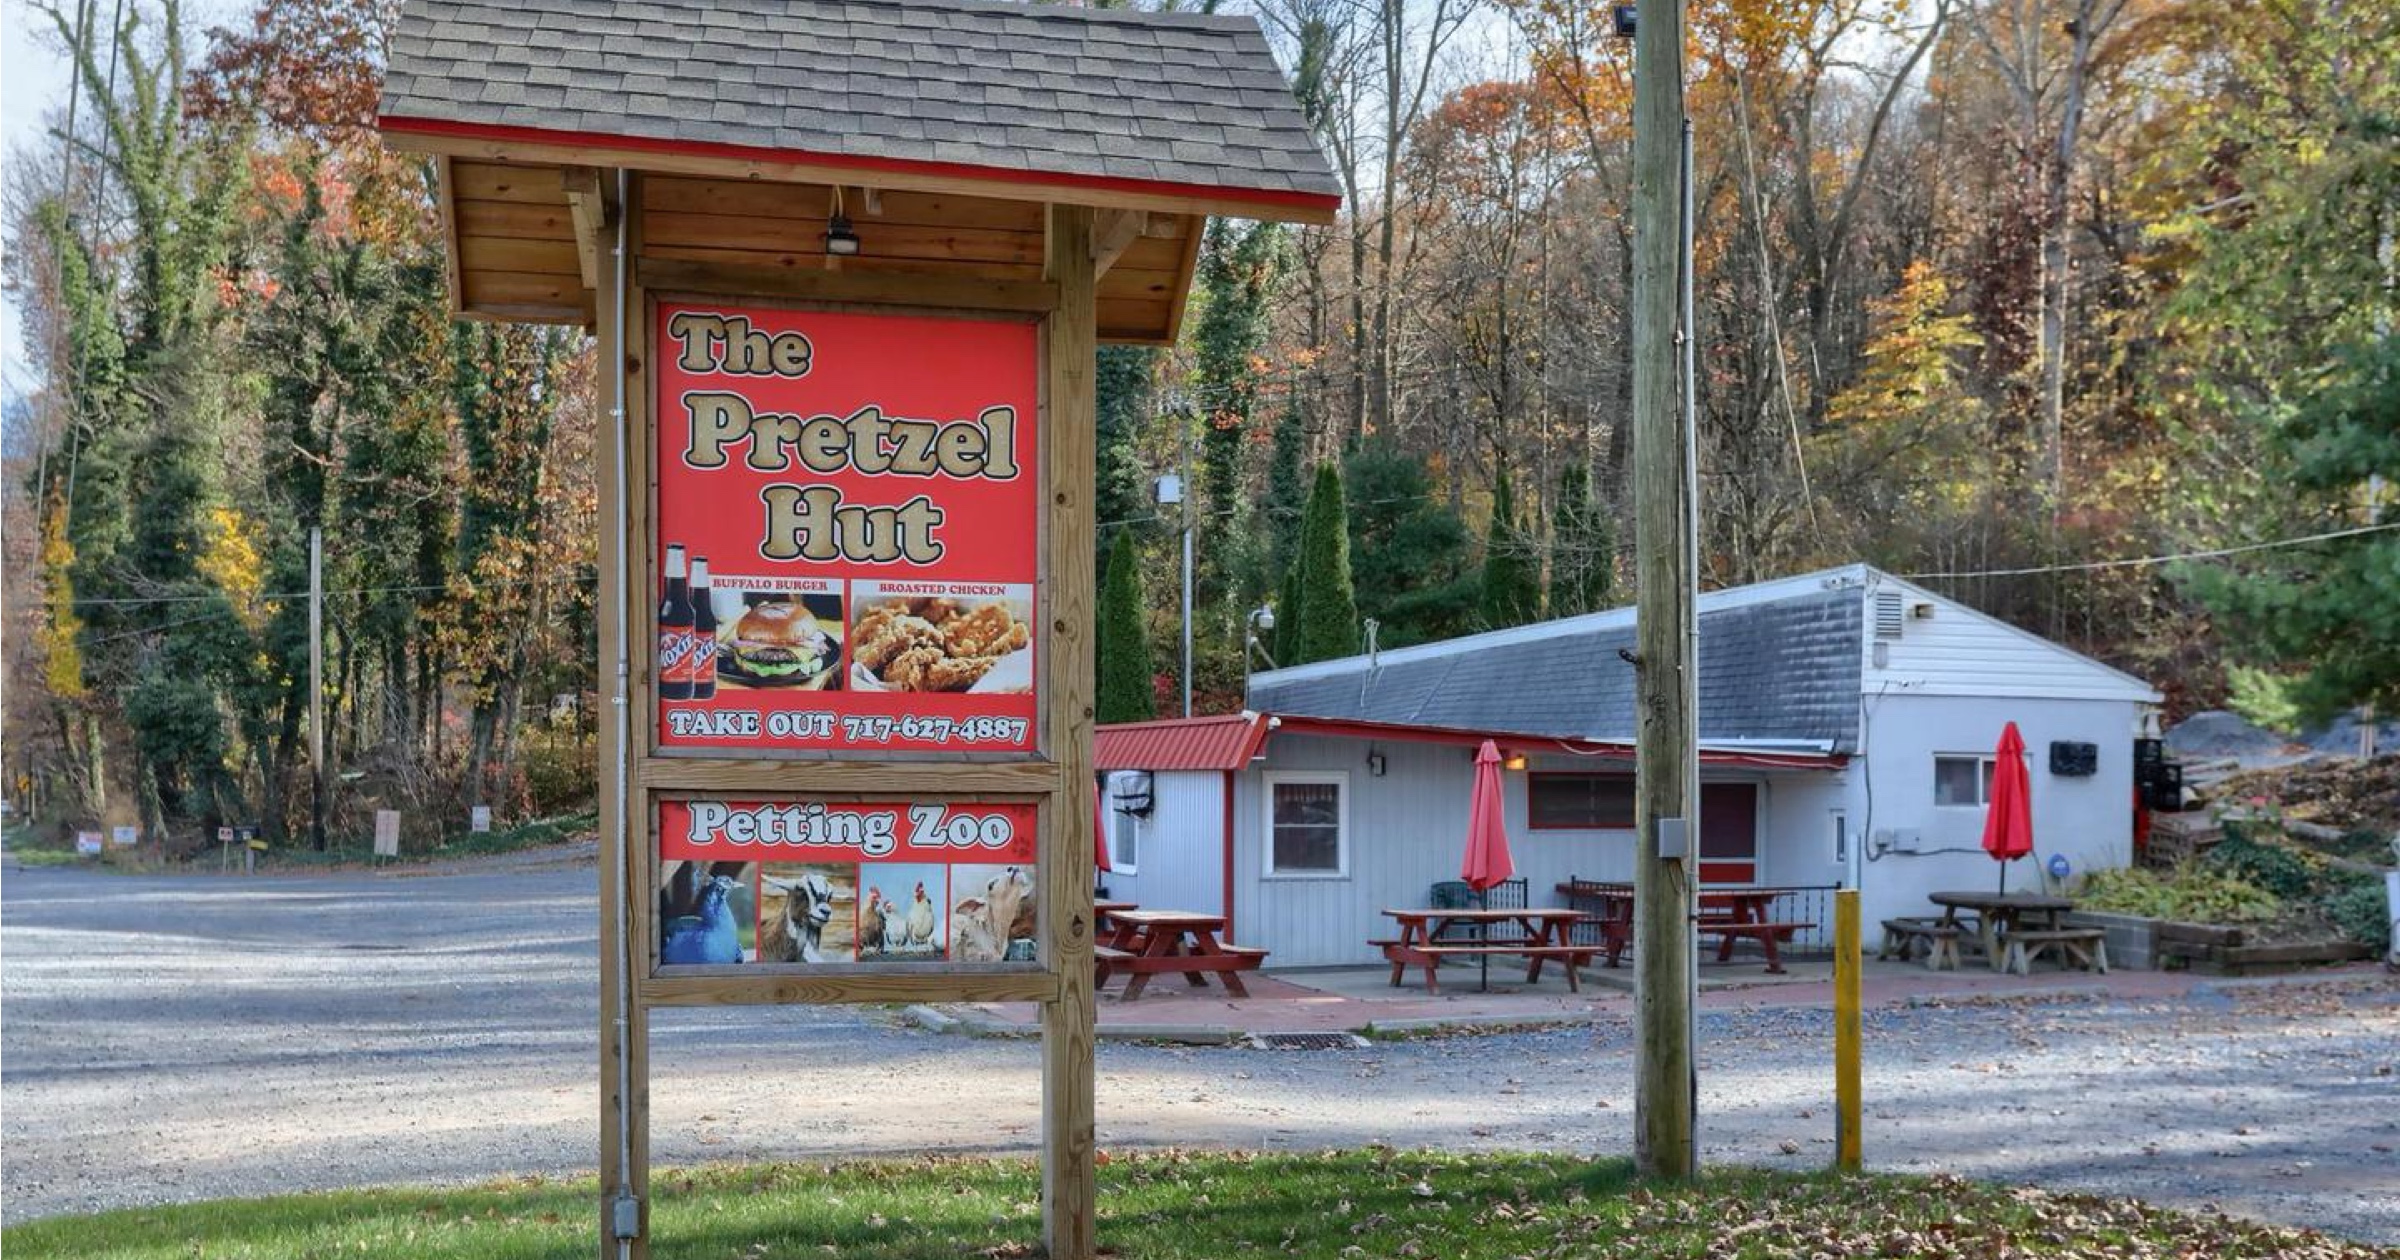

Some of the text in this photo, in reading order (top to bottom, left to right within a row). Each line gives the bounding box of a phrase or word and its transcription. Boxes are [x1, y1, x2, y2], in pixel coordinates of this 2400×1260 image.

[669, 312, 812, 376] The
[683, 392, 1019, 479] Pretzel
[760, 485, 944, 563] Hut
[712, 578, 828, 591] BUFFALO BURGER
[879, 583, 1006, 596] BROASTED CHICKEN
[668, 710, 1027, 743] TAKE OUT 717-627-4887
[689, 801, 1013, 855] Petting Zoo
